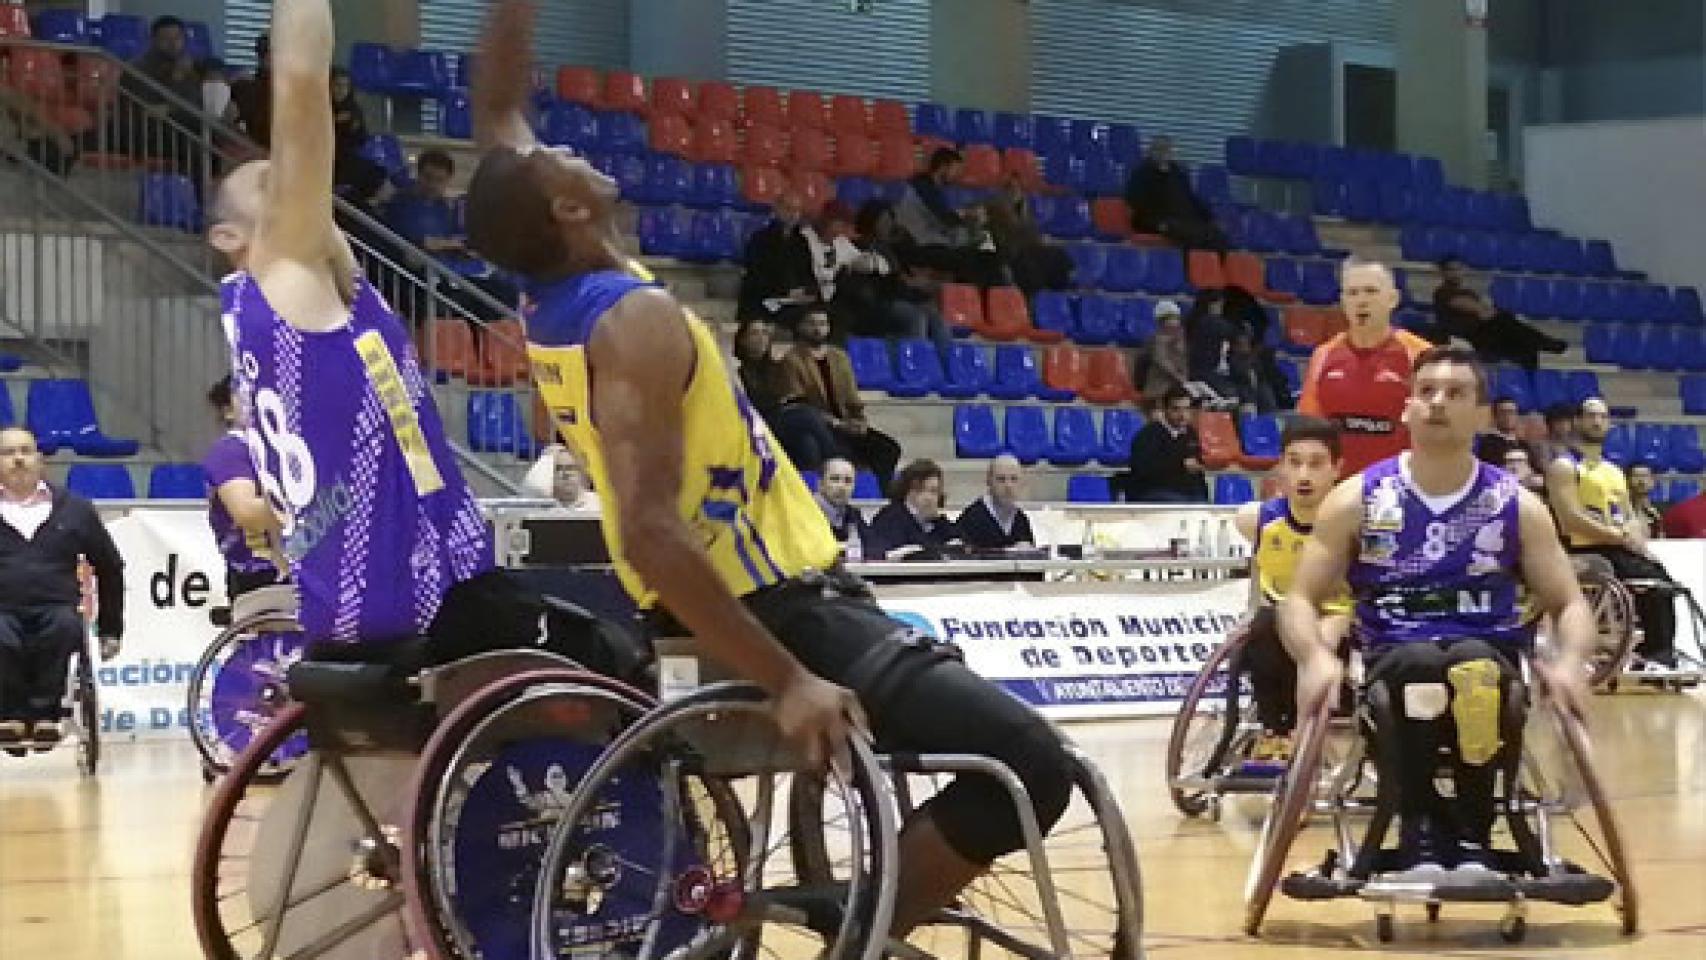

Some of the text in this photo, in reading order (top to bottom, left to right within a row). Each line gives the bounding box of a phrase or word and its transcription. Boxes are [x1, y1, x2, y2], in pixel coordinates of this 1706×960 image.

[1423, 522, 1446, 560] 8
[150, 553, 210, 609] de
[940, 613, 1108, 642] Fundación
[1021, 645, 1061, 668] de
[97, 657, 196, 686] ación
